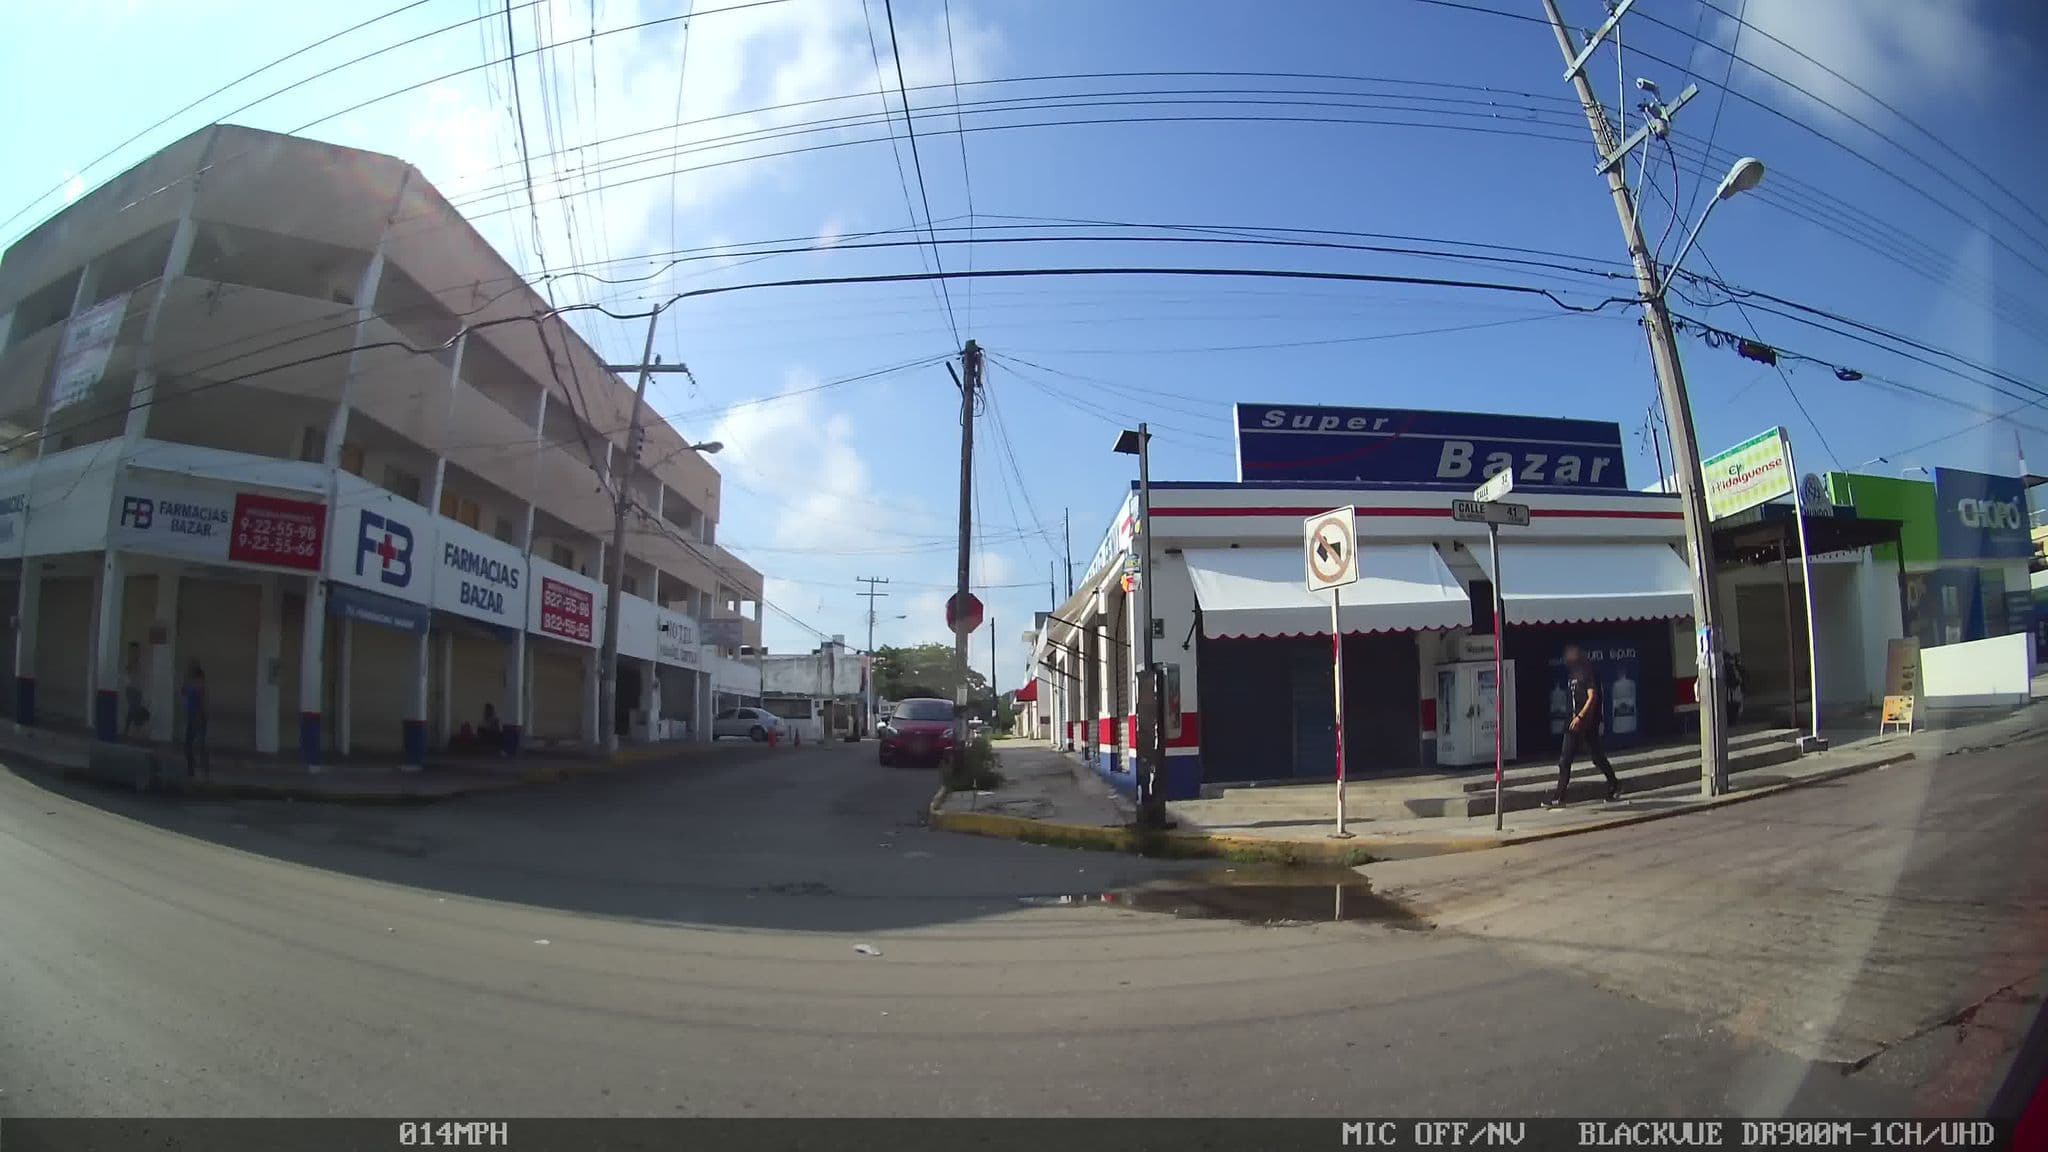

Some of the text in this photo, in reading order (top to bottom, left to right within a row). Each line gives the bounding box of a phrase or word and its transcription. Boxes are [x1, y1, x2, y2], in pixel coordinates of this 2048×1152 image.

[1262, 409, 1389, 432] Super
[1436, 440, 1611, 484] Bazar
[1711, 457, 1783, 494] Hidalguense
[160, 501, 229, 523] FARMACIAS
[1458, 503, 1517, 517] CALLE 41
[1958, 497, 2021, 530] CHOPO
[171, 518, 212, 537] BAZAR
[444, 542, 520, 589] FARMACIAS
[460, 581, 504, 615] BAZAR
